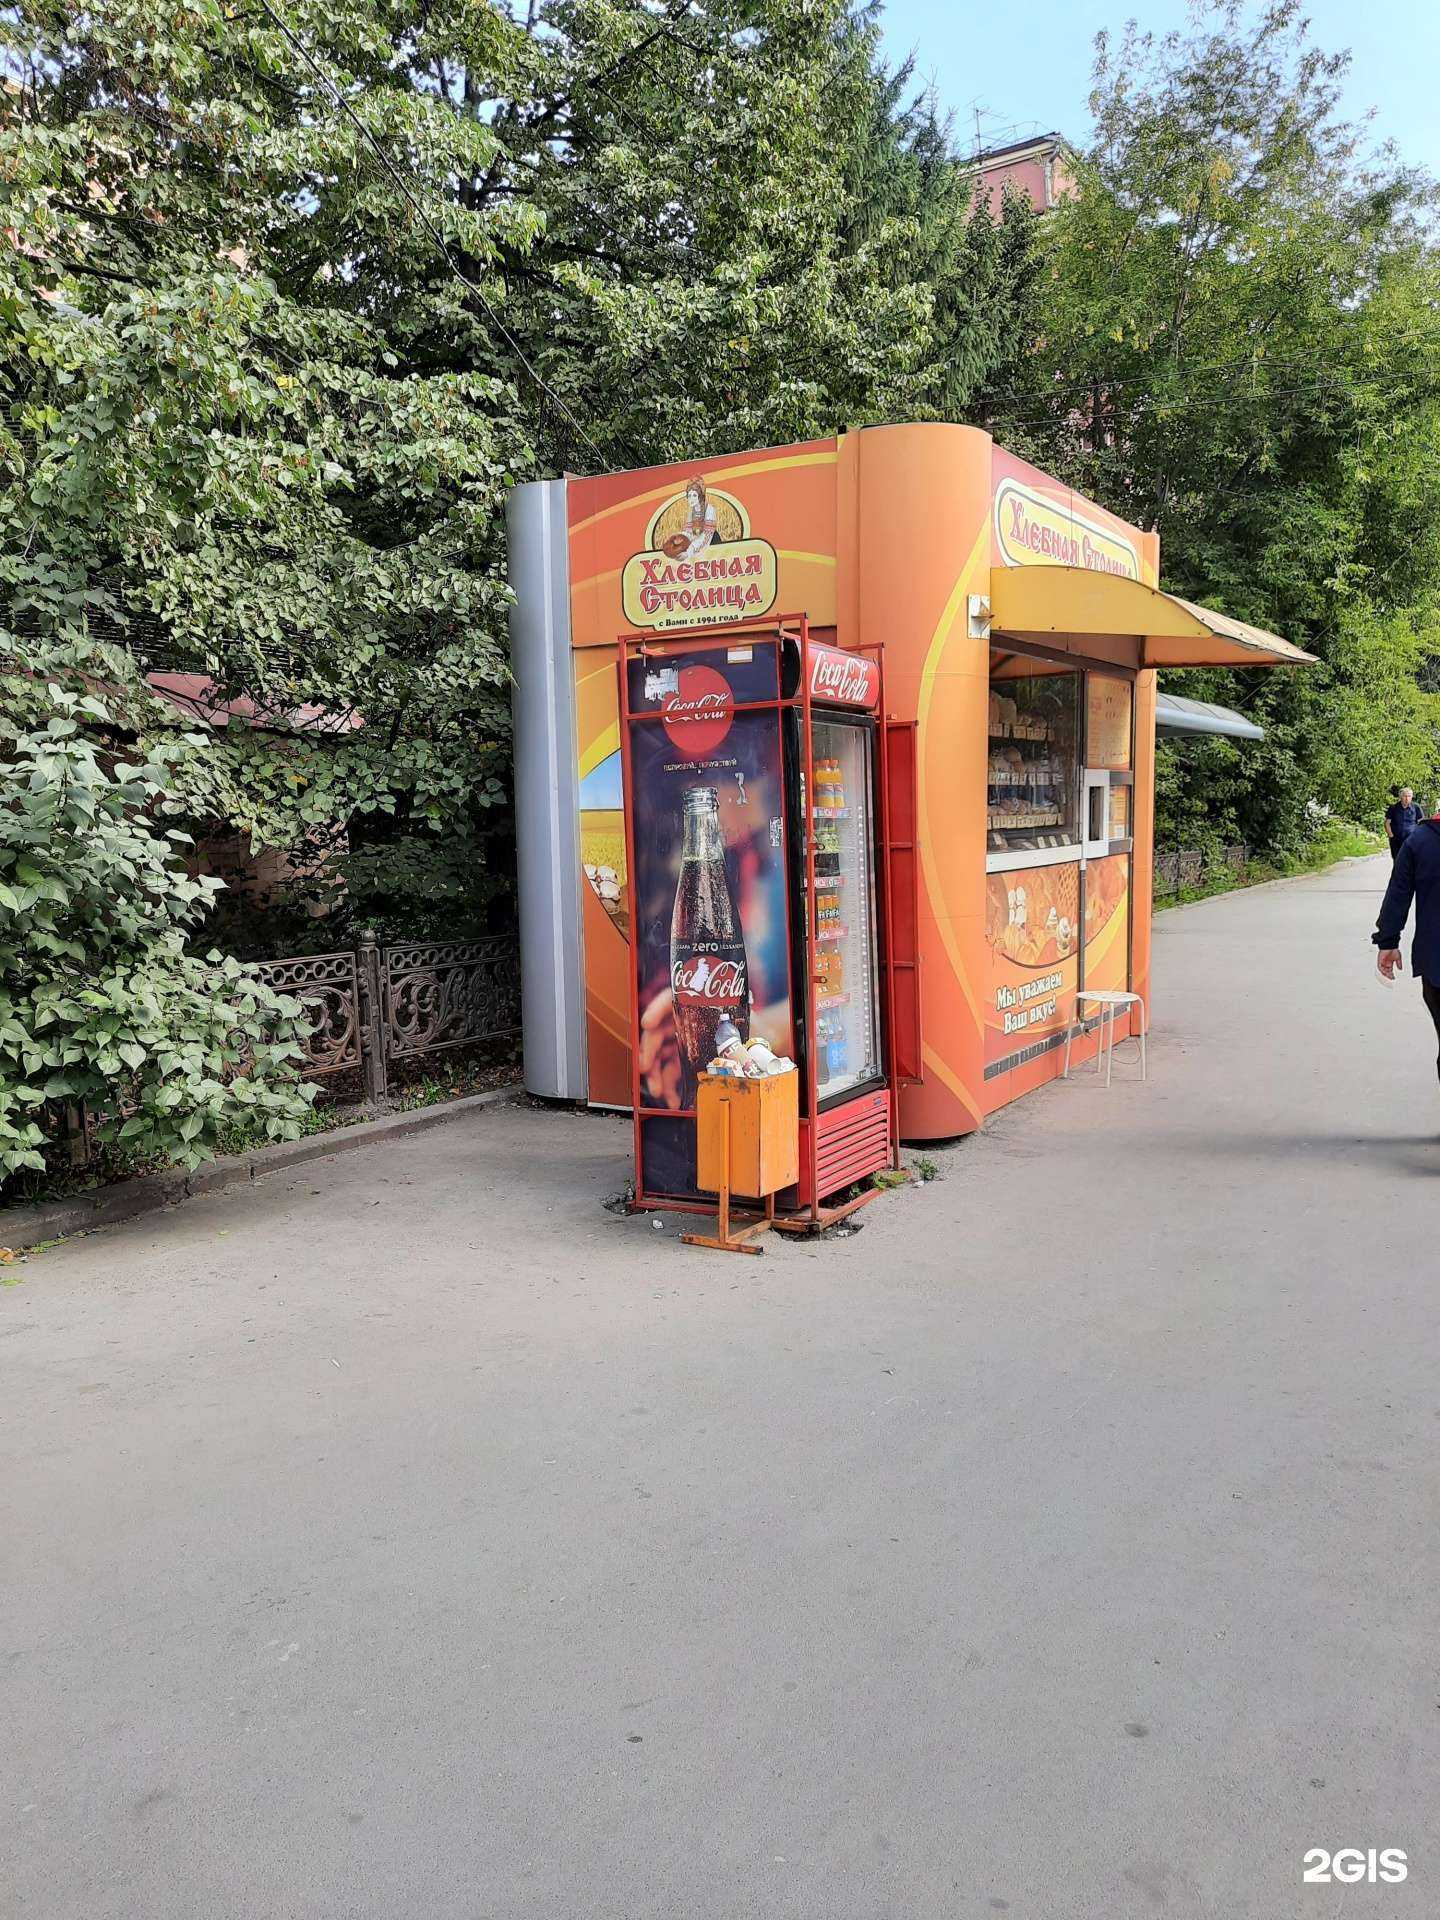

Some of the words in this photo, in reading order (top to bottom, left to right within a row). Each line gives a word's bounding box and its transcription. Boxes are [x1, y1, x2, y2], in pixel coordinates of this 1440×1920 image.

[665, 618, 688, 627] Вами
[697, 616, 717, 624] 1994
[718, 614, 739, 622] года
[811, 651, 869, 702] Coca-Cola
[692, 942, 719, 952] zero
[671, 960, 746, 998] CocCola
[996, 985, 1017, 1012] Мы
[1018, 970, 1063, 1007] уважаем
[1004, 1011, 1028, 1035] Ваш
[1030, 992, 1056, 1024] вкус!
